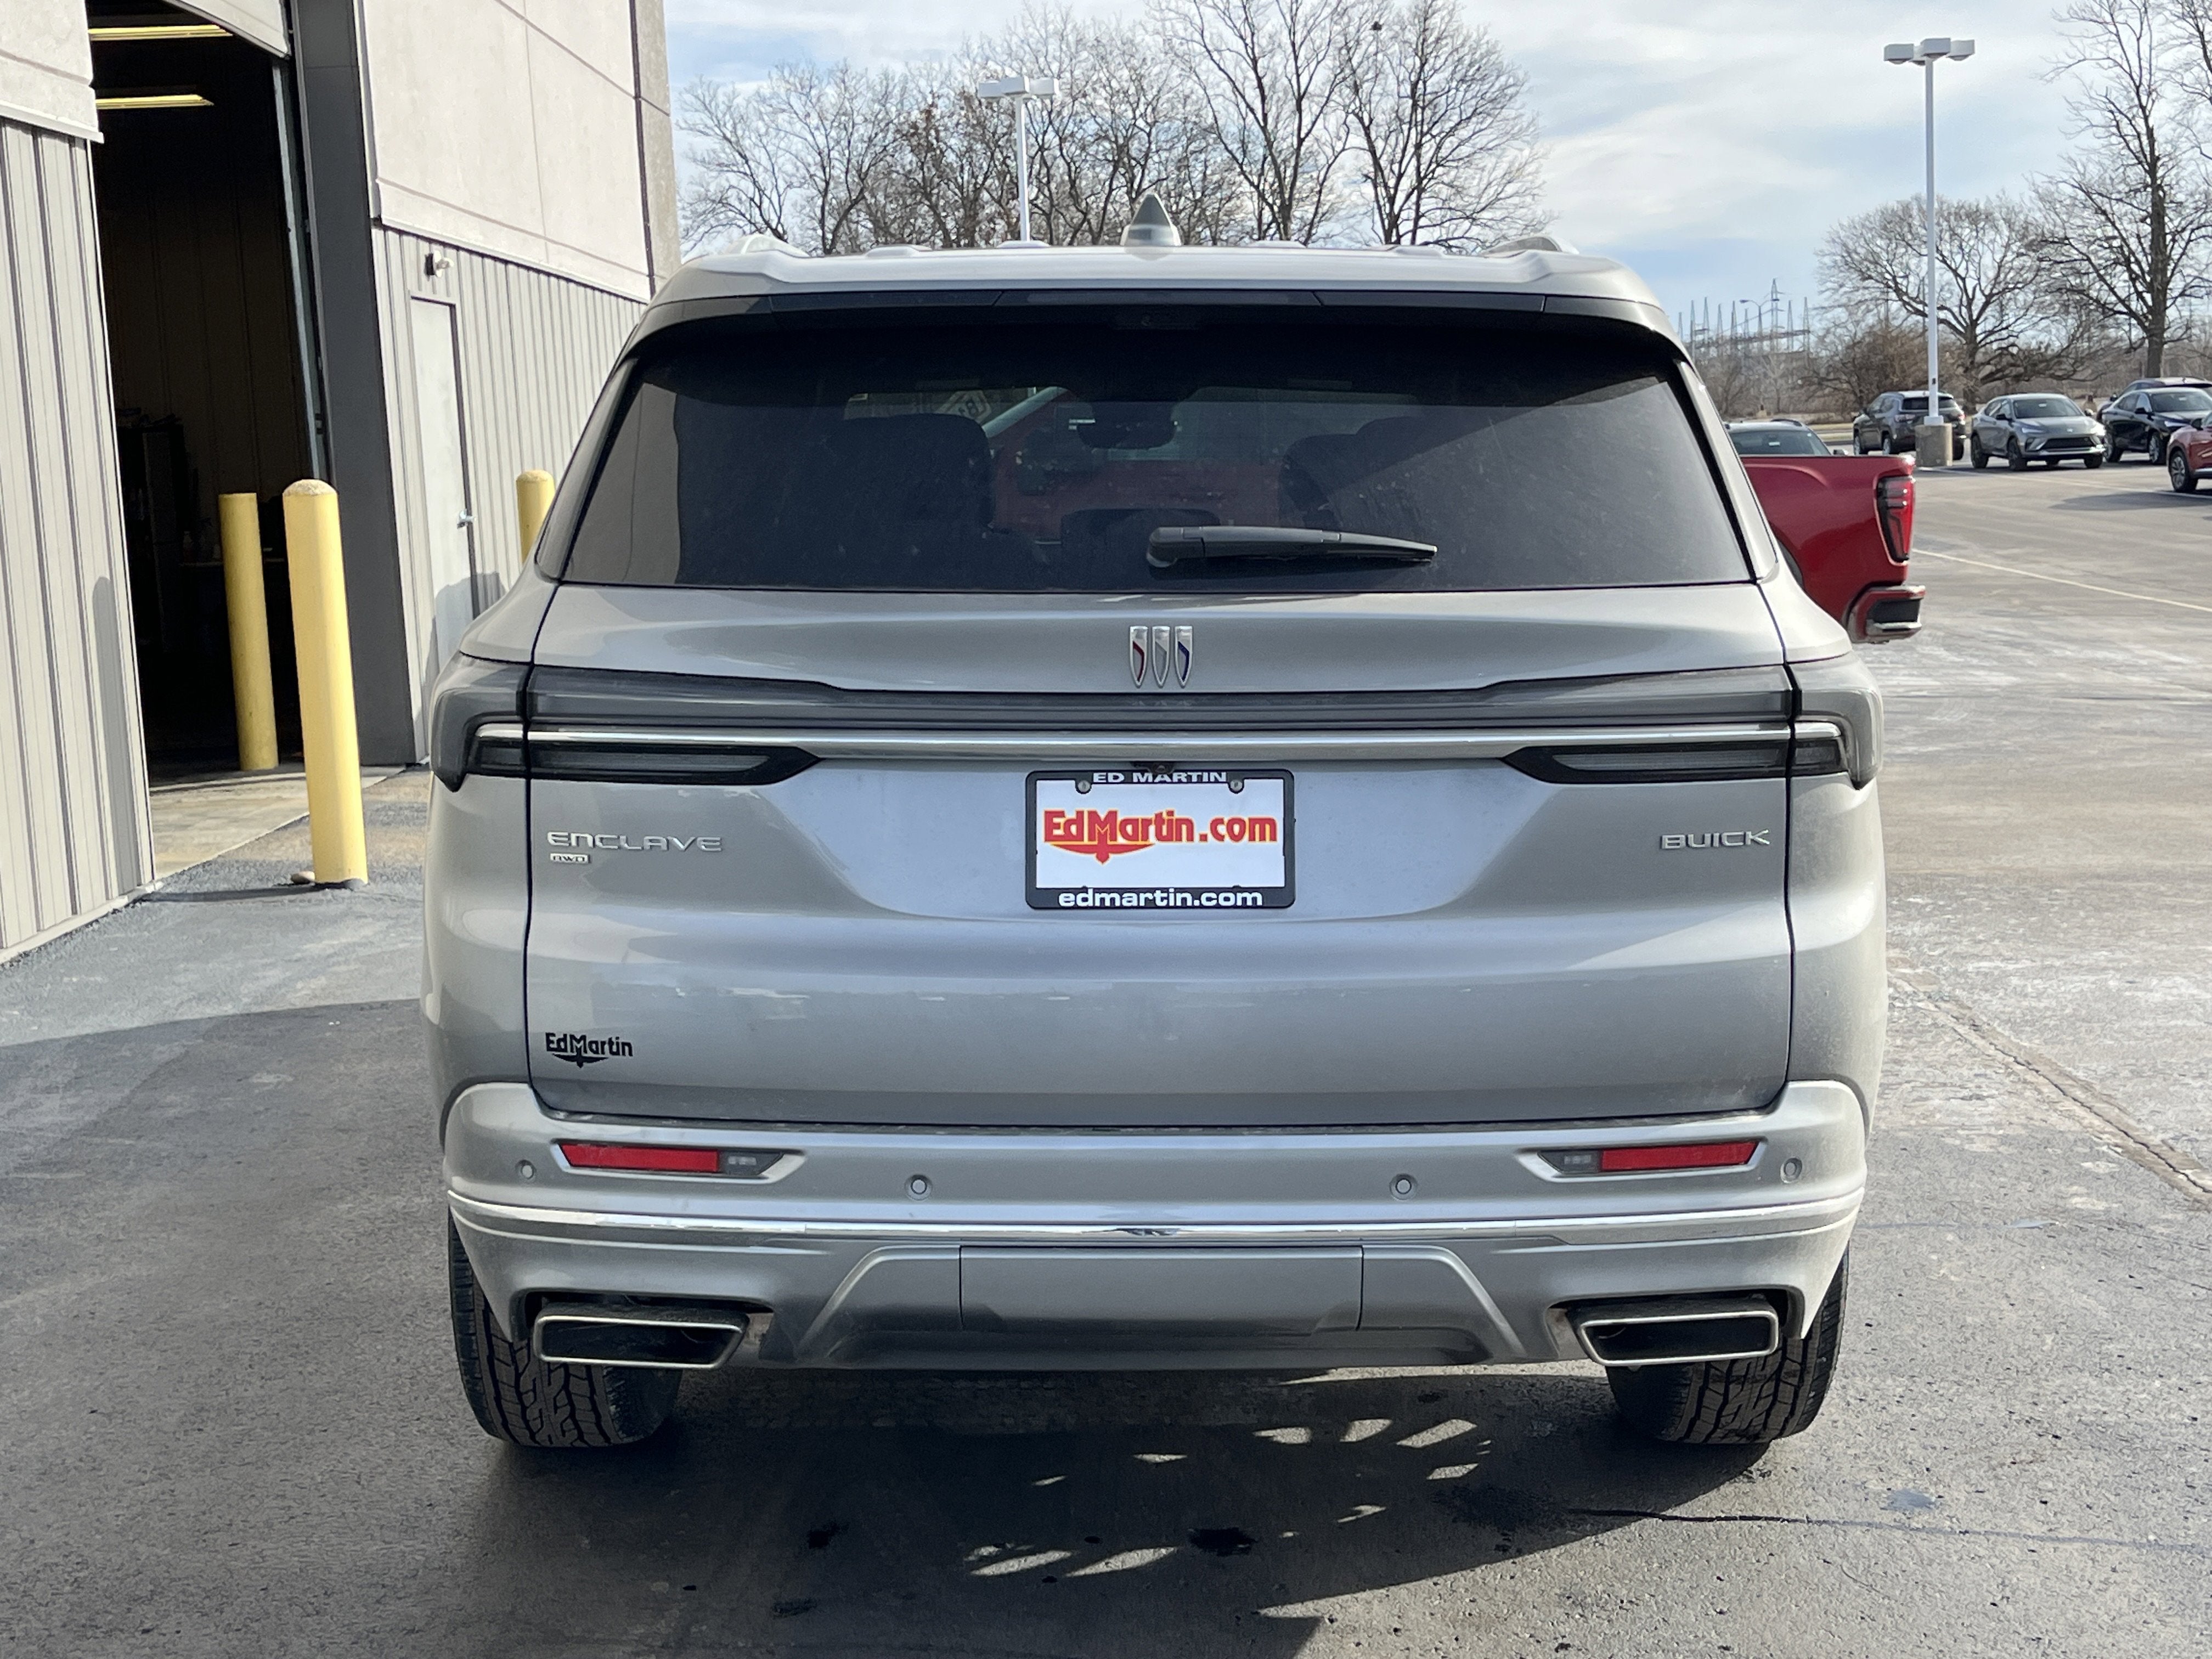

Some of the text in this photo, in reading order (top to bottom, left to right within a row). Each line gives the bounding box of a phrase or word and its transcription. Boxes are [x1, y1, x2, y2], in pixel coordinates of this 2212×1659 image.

[1092, 771, 1227, 783] ED MARTIN
[546, 831, 722, 851] ENCLAVE
[1043, 809, 1278, 854] EdMartin.com
[1661, 828, 1770, 850] BUICK
[551, 854, 586, 863] AWD
[1058, 887, 1263, 907] edmartin.com
[545, 1032, 633, 1063] EdMartin
